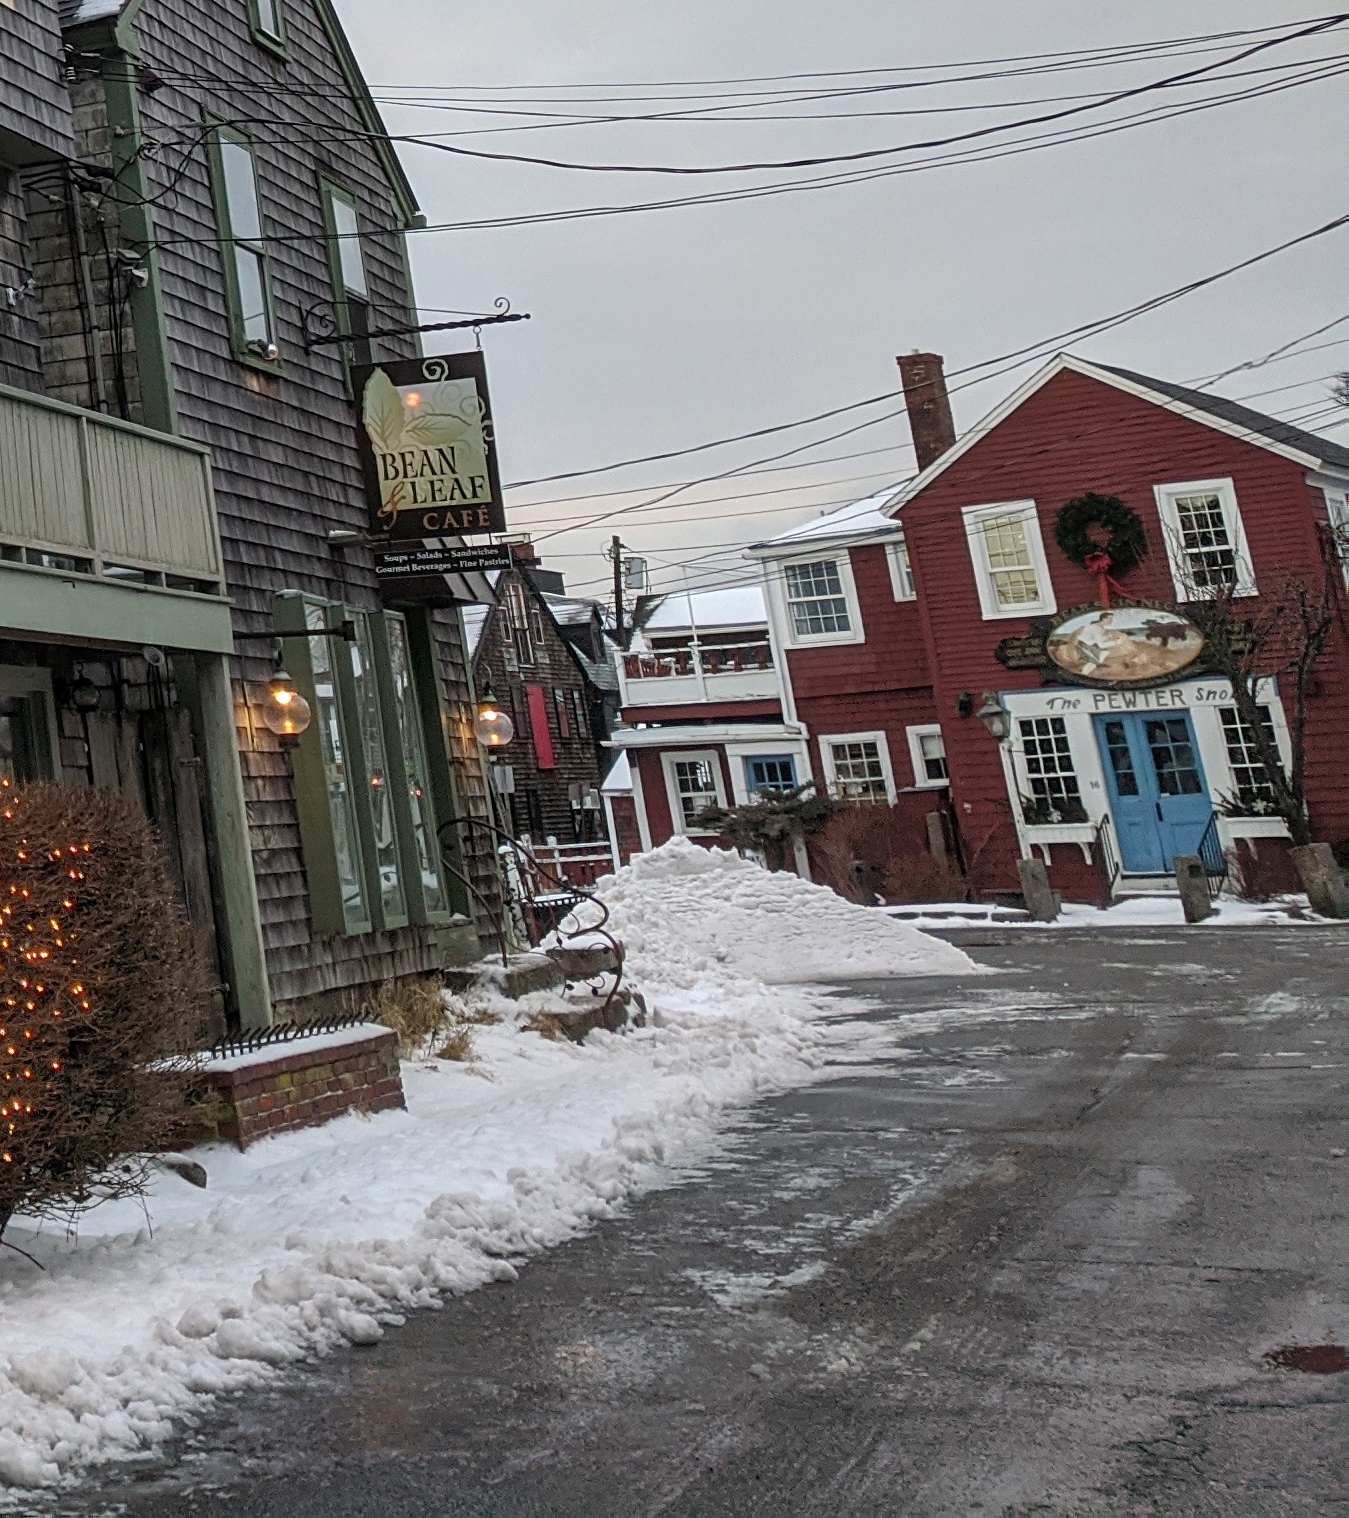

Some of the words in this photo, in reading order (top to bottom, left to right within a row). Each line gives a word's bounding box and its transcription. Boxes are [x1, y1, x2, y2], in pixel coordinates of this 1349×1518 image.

[379, 445, 459, 482] BEAN
[409, 474, 486, 505] LEAF
[422, 505, 491, 532] CAFÉ
[384, 554, 408, 564] Soups
[416, 550, 442, 560] Salads
[450, 547, 499, 558] Sandwiches
[411, 561, 451, 572] Beverages
[459, 559, 477, 568] Fine
[478, 557, 510, 567] Pastries
[1046, 696, 1081, 710] The
[1092, 687, 1188, 711] PEWTER
[1195, 686, 1233, 702] Sho
